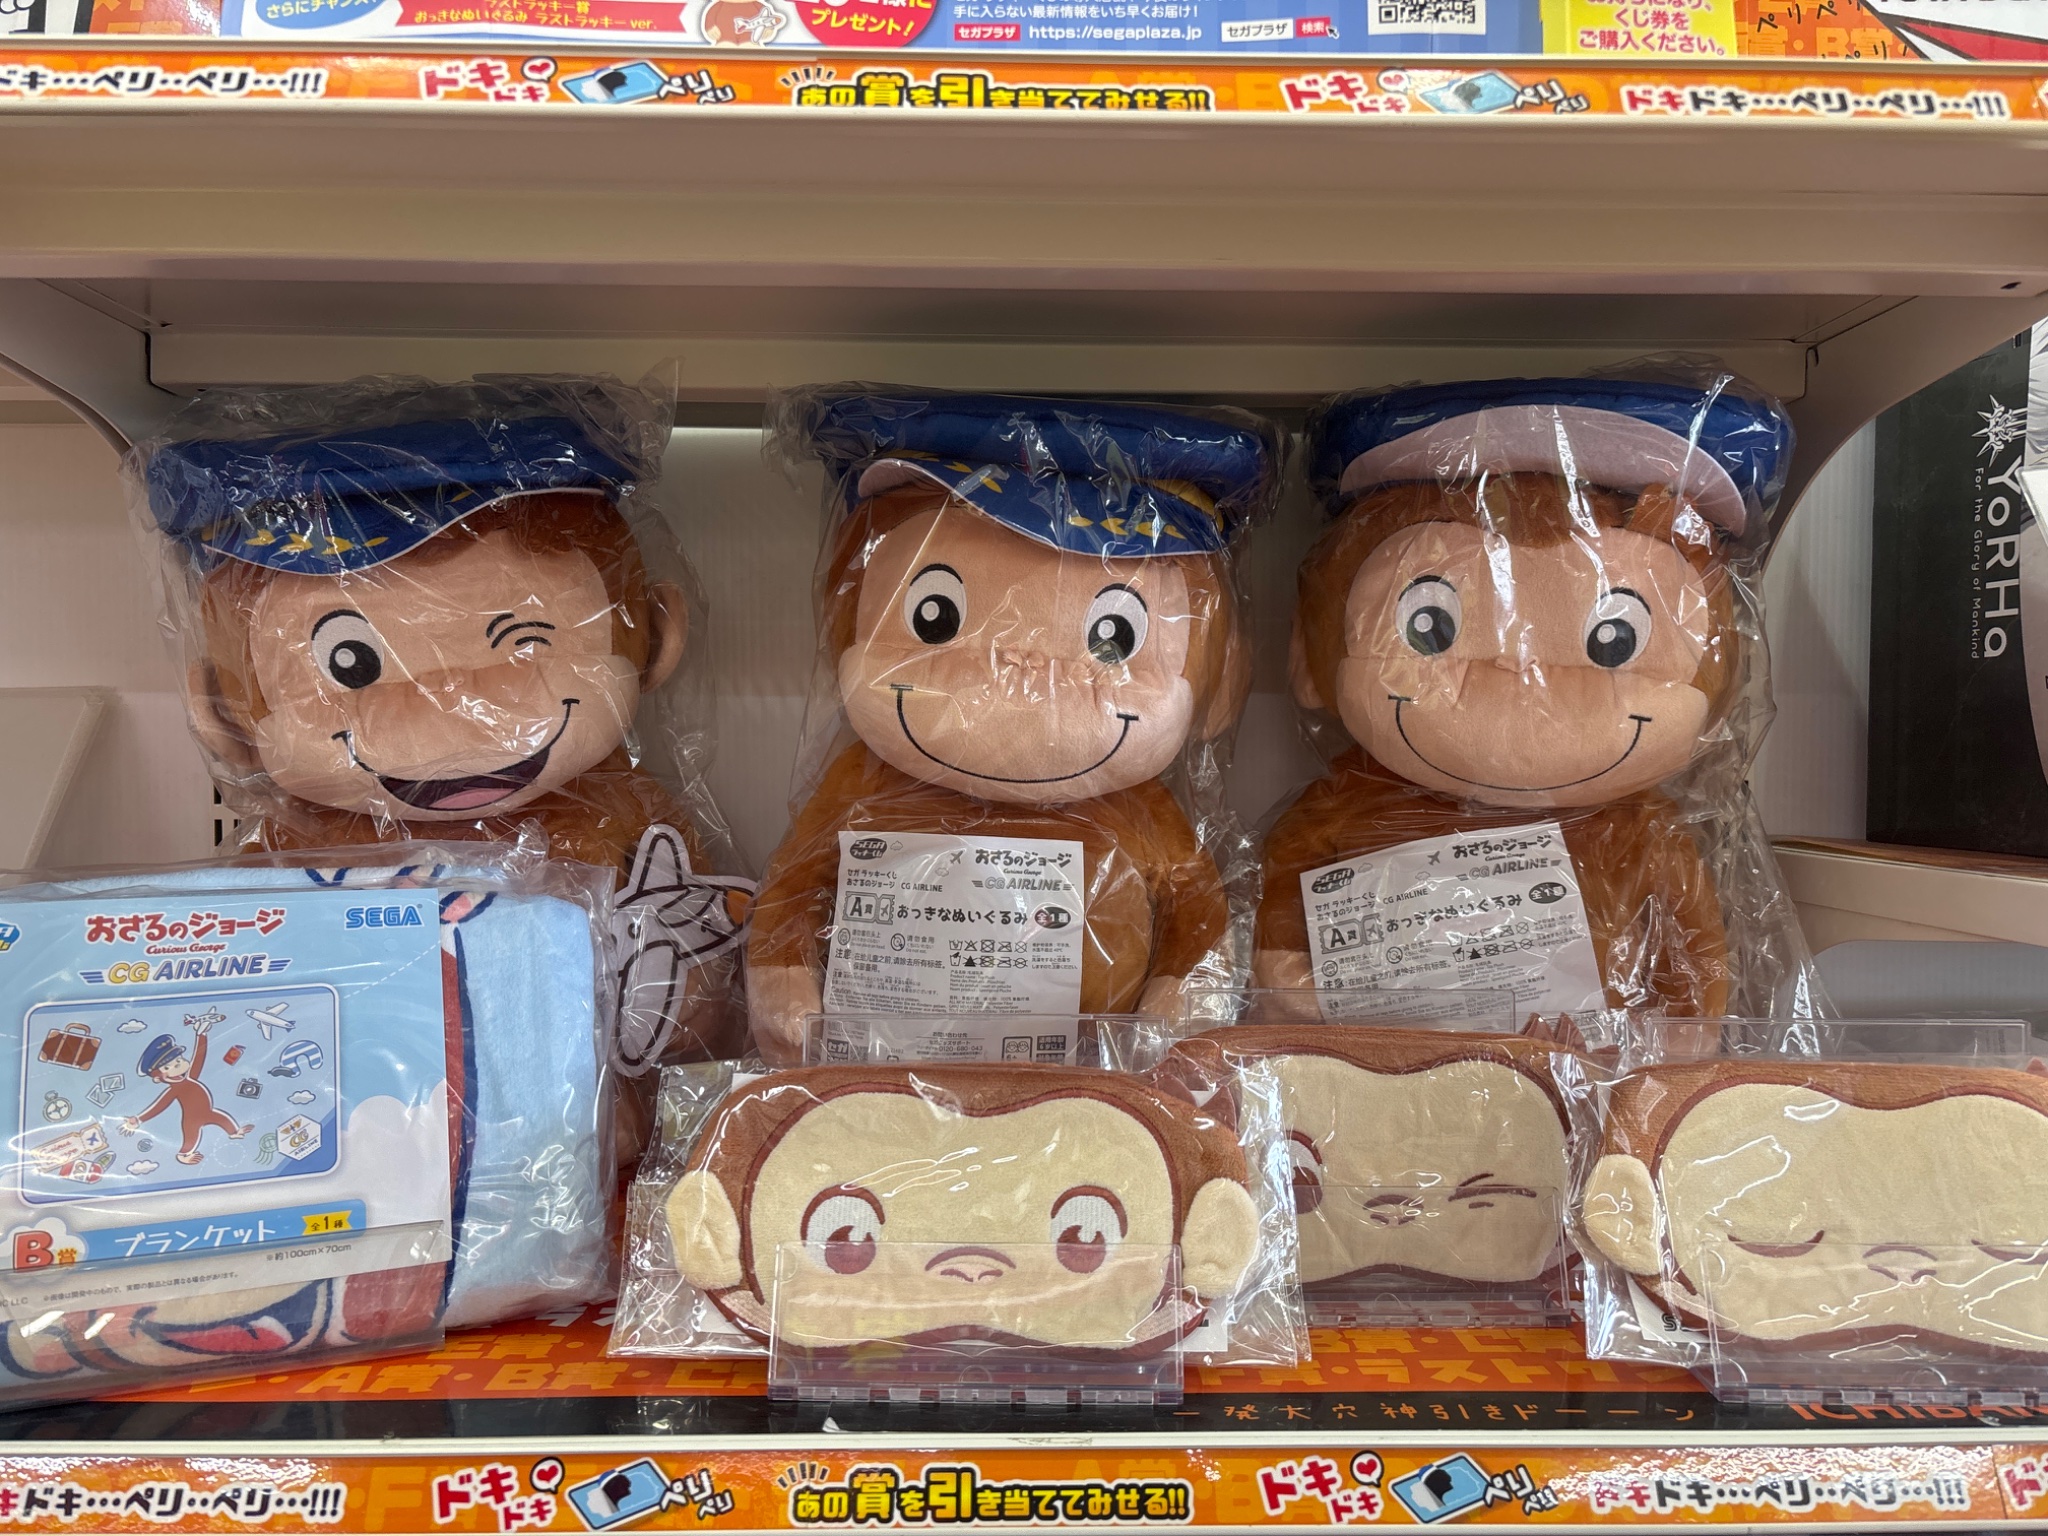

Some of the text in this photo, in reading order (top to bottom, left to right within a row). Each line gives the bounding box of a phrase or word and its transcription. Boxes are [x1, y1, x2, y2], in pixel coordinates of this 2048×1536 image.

[535, 13, 627, 28] ラストラッキー
[630, 19, 658, 30] ver.
[1226, 22, 1326, 39] セガプラザ 検索
[1615, 8, 1690, 31] くじ券を
[958, 25, 1202, 40] セガプラザ https://segaplaza.jp
[1579, 29, 1726, 56] ご購入ください。
[1971, 467, 1984, 659] For the Glory of Mankind
[975, 848, 1073, 868] おさるのジョージ
[1451, 834, 1552, 858] おさるのジョージ
[1469, 858, 1548, 880] CG AIRLINE
[901, 882, 911, 890] CG
[913, 883, 943, 893] AIRLINE
[985, 877, 1062, 891] CG AIRLINE
[1396, 888, 1429, 902] AIRLINE
[86, 905, 423, 943] おさるのジョージ SEGA
[897, 904, 1028, 926] おっきなぬいぐるみ
[146, 942, 226, 955] Curious George
[108, 954, 267, 984] CG AIRLINE
[115, 1219, 276, 1258] ブランケット
[437, 1468, 513, 1518] ドキ
[796, 1471, 1186, 1518] あの賞を引き当ててみせる!!
[1261, 1460, 1337, 1511] ドキ
[2004, 1463, 2048, 1507] ド
[503, 1498, 552, 1530] ドキ
[1331, 1491, 1379, 1523] ドキ
